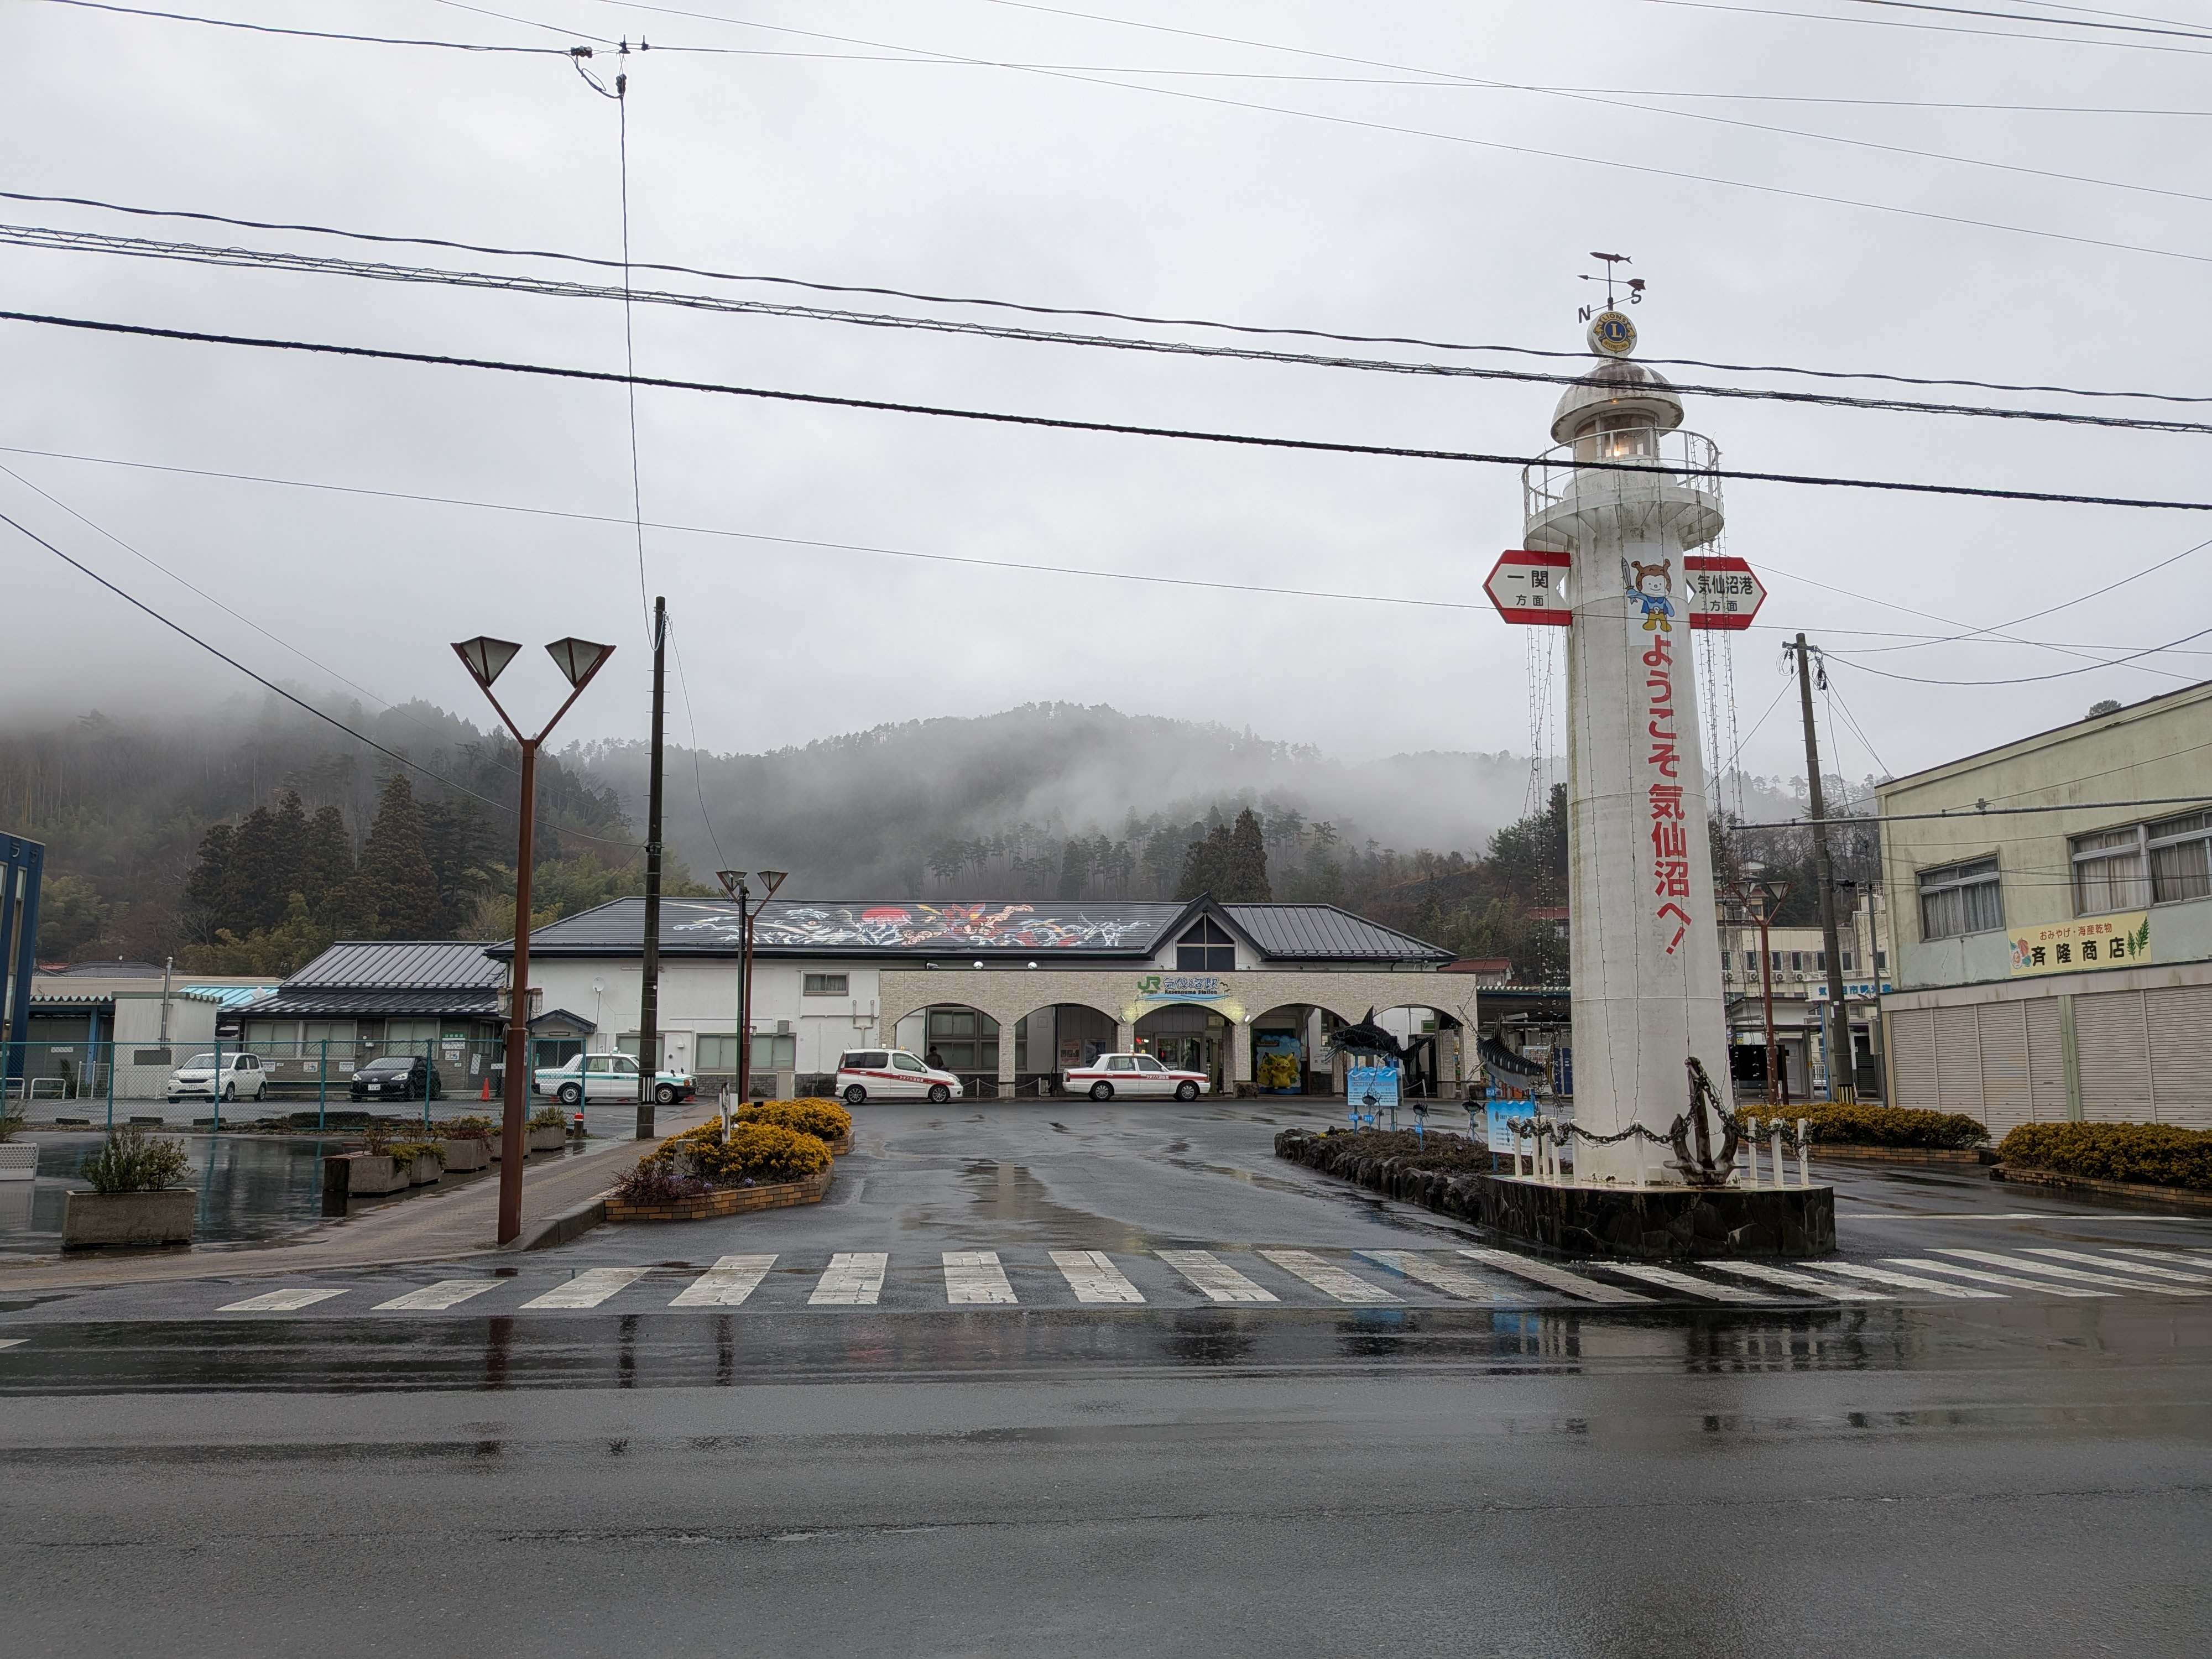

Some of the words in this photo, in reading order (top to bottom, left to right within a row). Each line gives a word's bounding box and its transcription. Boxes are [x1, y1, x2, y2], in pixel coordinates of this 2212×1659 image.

[1578, 304, 1590, 324] N
[1601, 313, 1627, 324] LIONS
[1610, 324, 1623, 338] L
[1603, 341, 1628, 349] INTERNATIONAL
[1507, 570, 1548, 588] 一関
[1698, 575, 1753, 594] 気仙沼港
[1515, 594, 1543, 606] 方面
[1709, 599, 1738, 611] 方面
[1138, 976, 1161, 990] JR
[1163, 977, 1219, 989] 気仙沼駅
